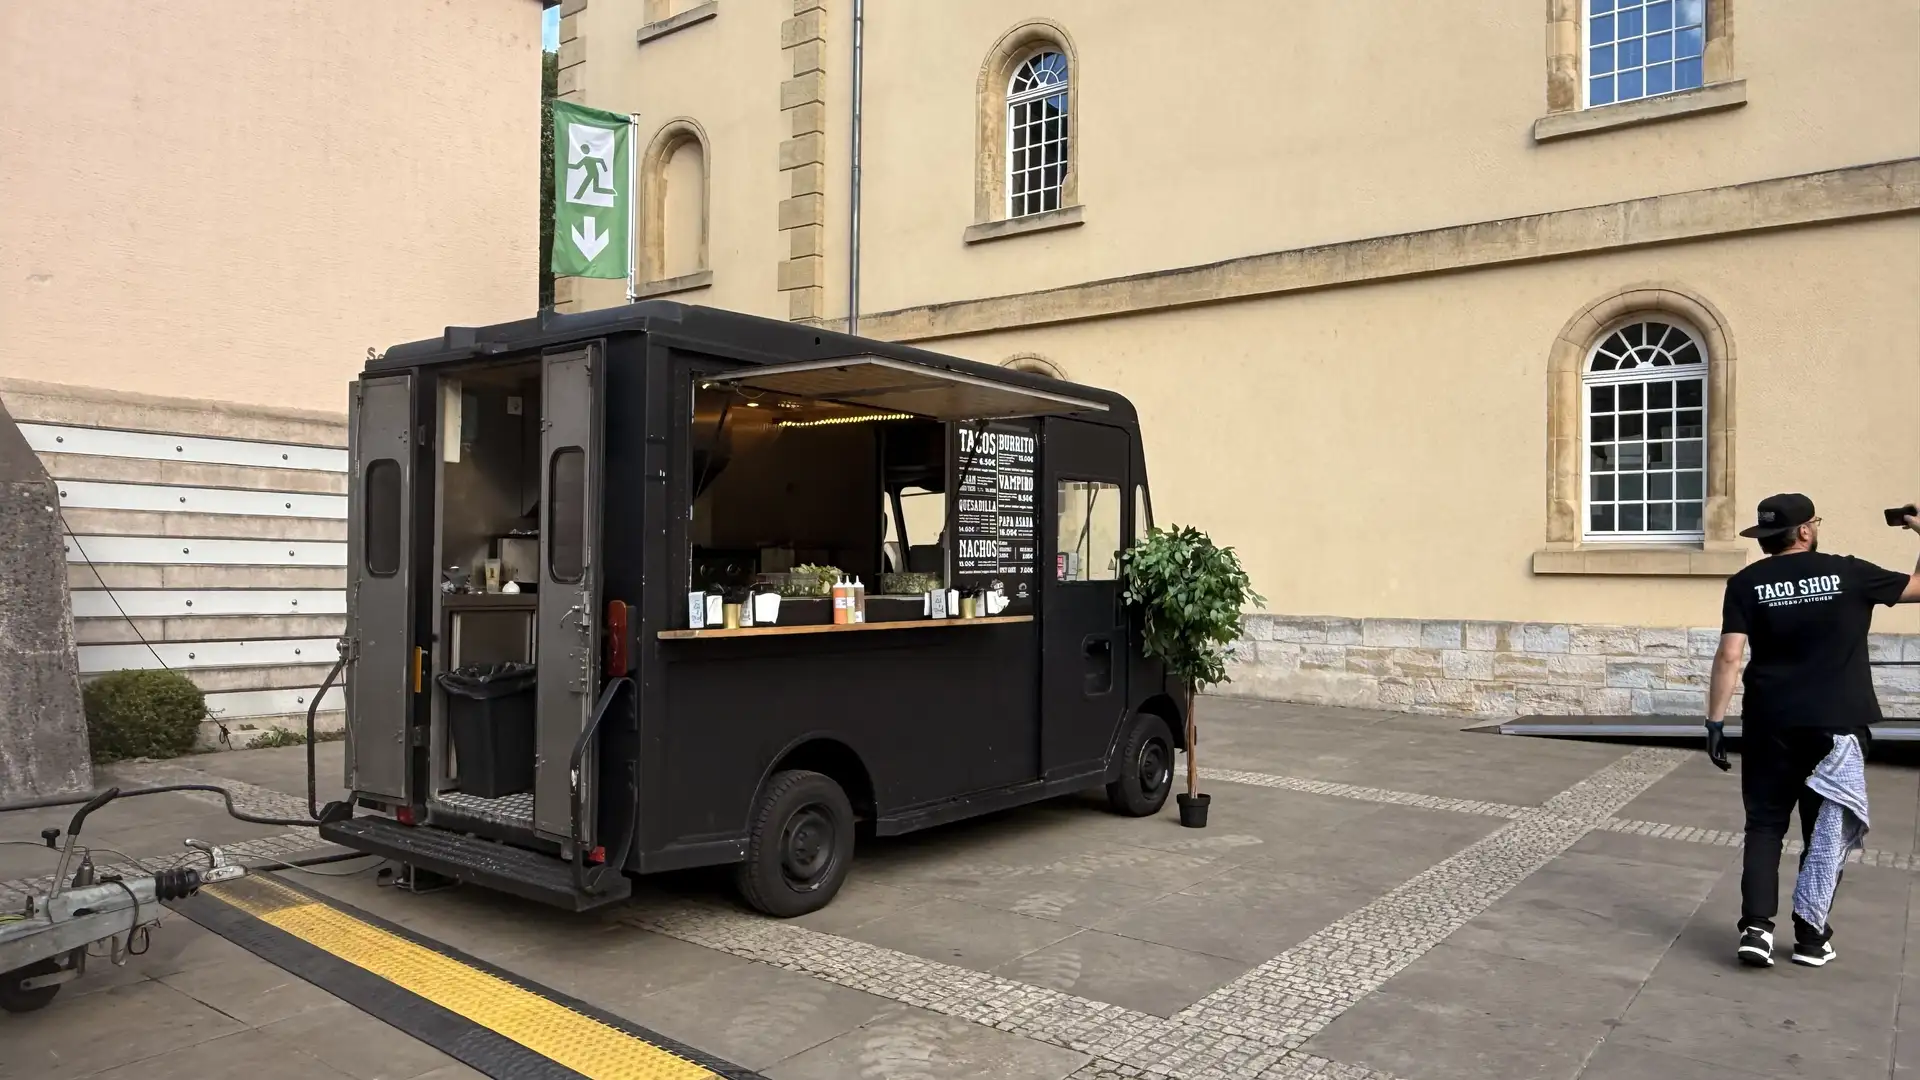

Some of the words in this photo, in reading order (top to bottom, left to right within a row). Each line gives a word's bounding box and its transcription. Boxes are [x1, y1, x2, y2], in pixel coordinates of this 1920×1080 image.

[999, 434, 1034, 454] BURRITO
[999, 474, 1034, 491] VAMPIRO
[959, 499, 997, 512] QUESADILLA
[999, 516, 1014, 527] PAPA
[1015, 516, 1034, 528] ASADA
[959, 539, 997, 558] NACHOS
[1754, 581, 1795, 600] TACO
[1799, 574, 1841, 595] SHOP
[1804, 595, 1833, 603] KITCHEN
